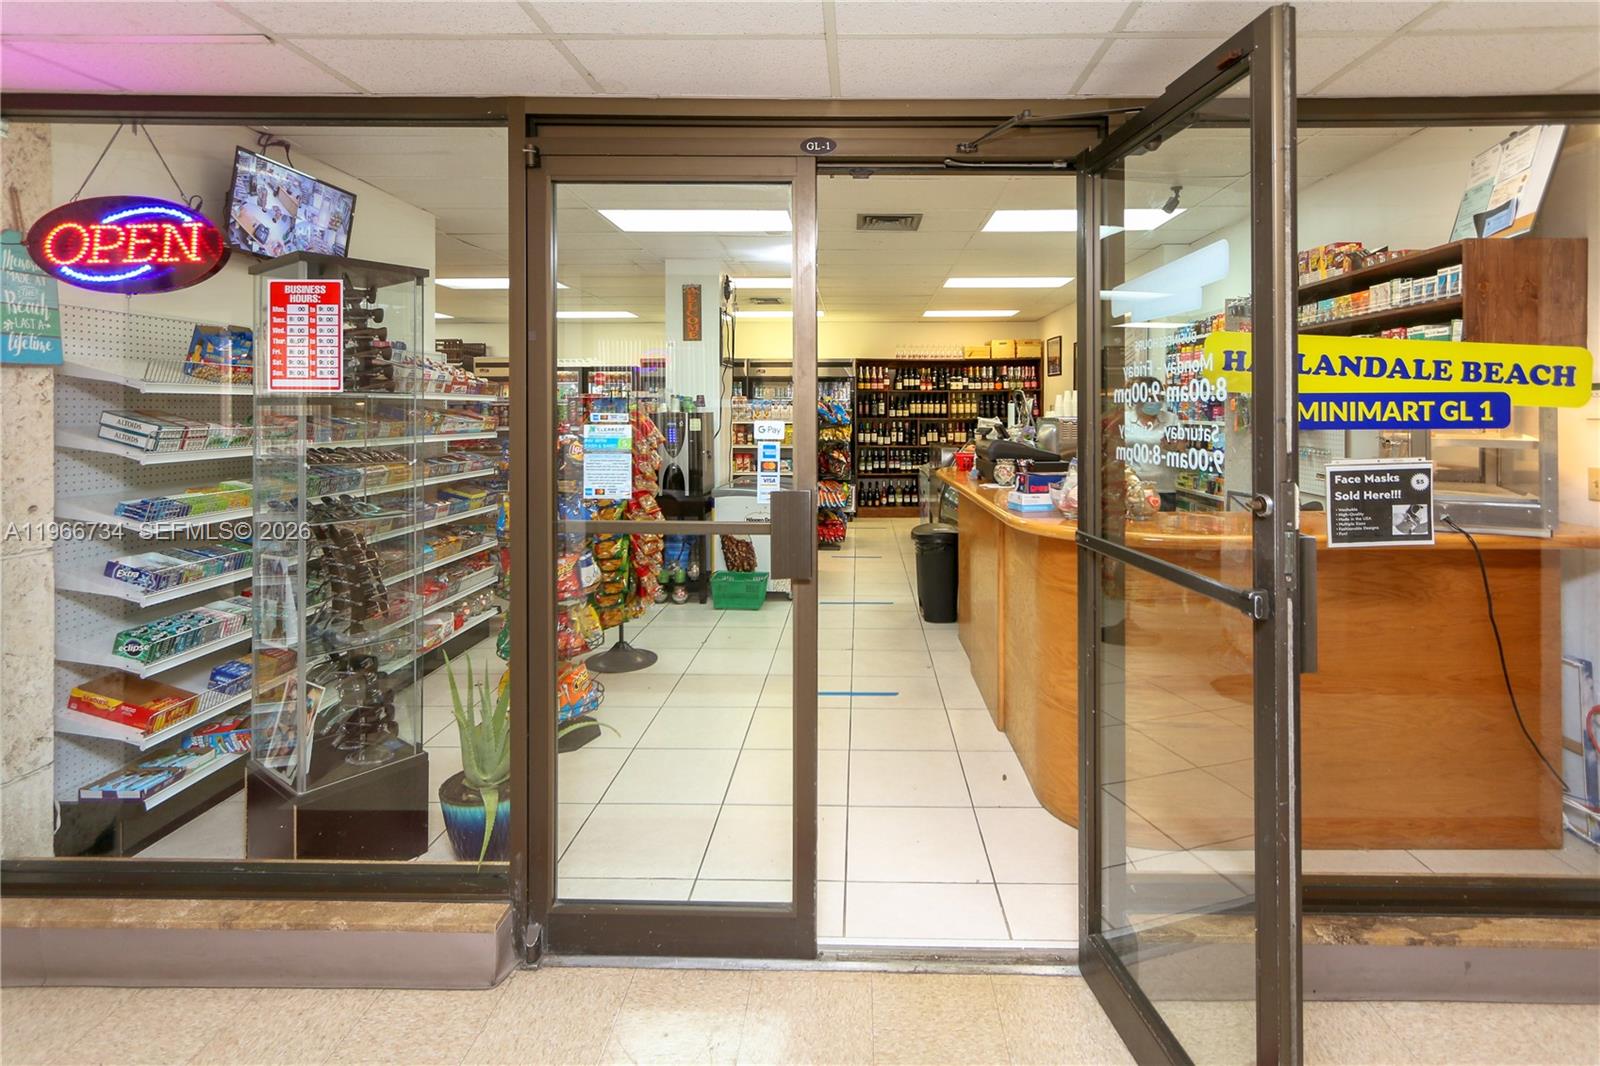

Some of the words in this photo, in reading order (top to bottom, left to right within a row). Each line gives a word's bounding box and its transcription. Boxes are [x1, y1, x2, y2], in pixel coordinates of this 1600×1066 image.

[806, 141, 830, 151] GL-1
[44, 222, 204, 265] OPEN
[284, 285, 327, 294] BUSINESS
[289, 294, 322, 303] HOURS:
[1222, 349, 1453, 382] HLANDALE
[1461, 361, 1577, 388] BEACH
[1298, 400, 1436, 422] MINIMART
[1440, 399, 1474, 422] GL
[1479, 400, 1494, 421] 1
[117, 418, 142, 430] ALTOIDS
[768, 426, 781, 435] Pay
[114, 432, 139, 443] ALTOIDS
[1334, 474, 1361, 484] Face
[1364, 473, 1400, 484] Masks
[1334, 490, 1360, 501] Sold
[1363, 490, 1402, 500] Here!!!
[116, 569, 140, 578] Extra
[118, 643, 151, 652] eclipse
